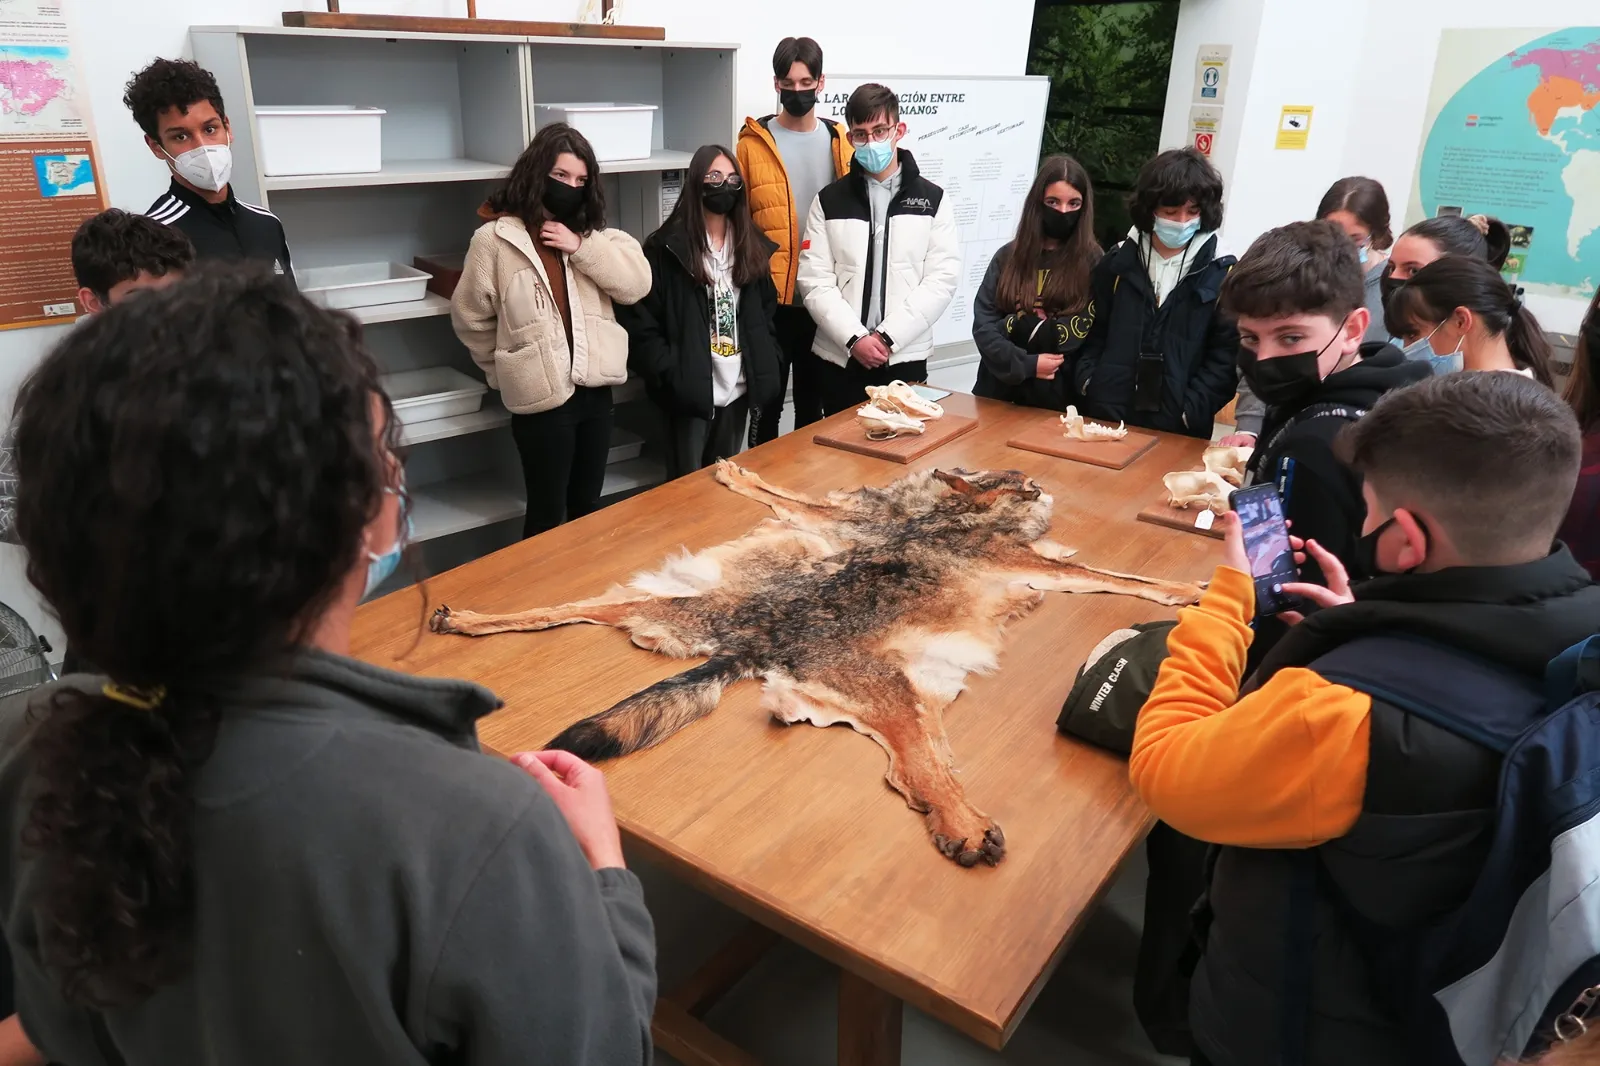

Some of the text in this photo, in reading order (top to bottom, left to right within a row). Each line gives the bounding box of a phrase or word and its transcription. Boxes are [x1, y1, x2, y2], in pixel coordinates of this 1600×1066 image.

[824, 93, 849, 104] LAR
[929, 93, 966, 103] ENTRE
[899, 105, 939, 115] MANOS
[1089, 657, 1128, 712] WINTER CLASH
